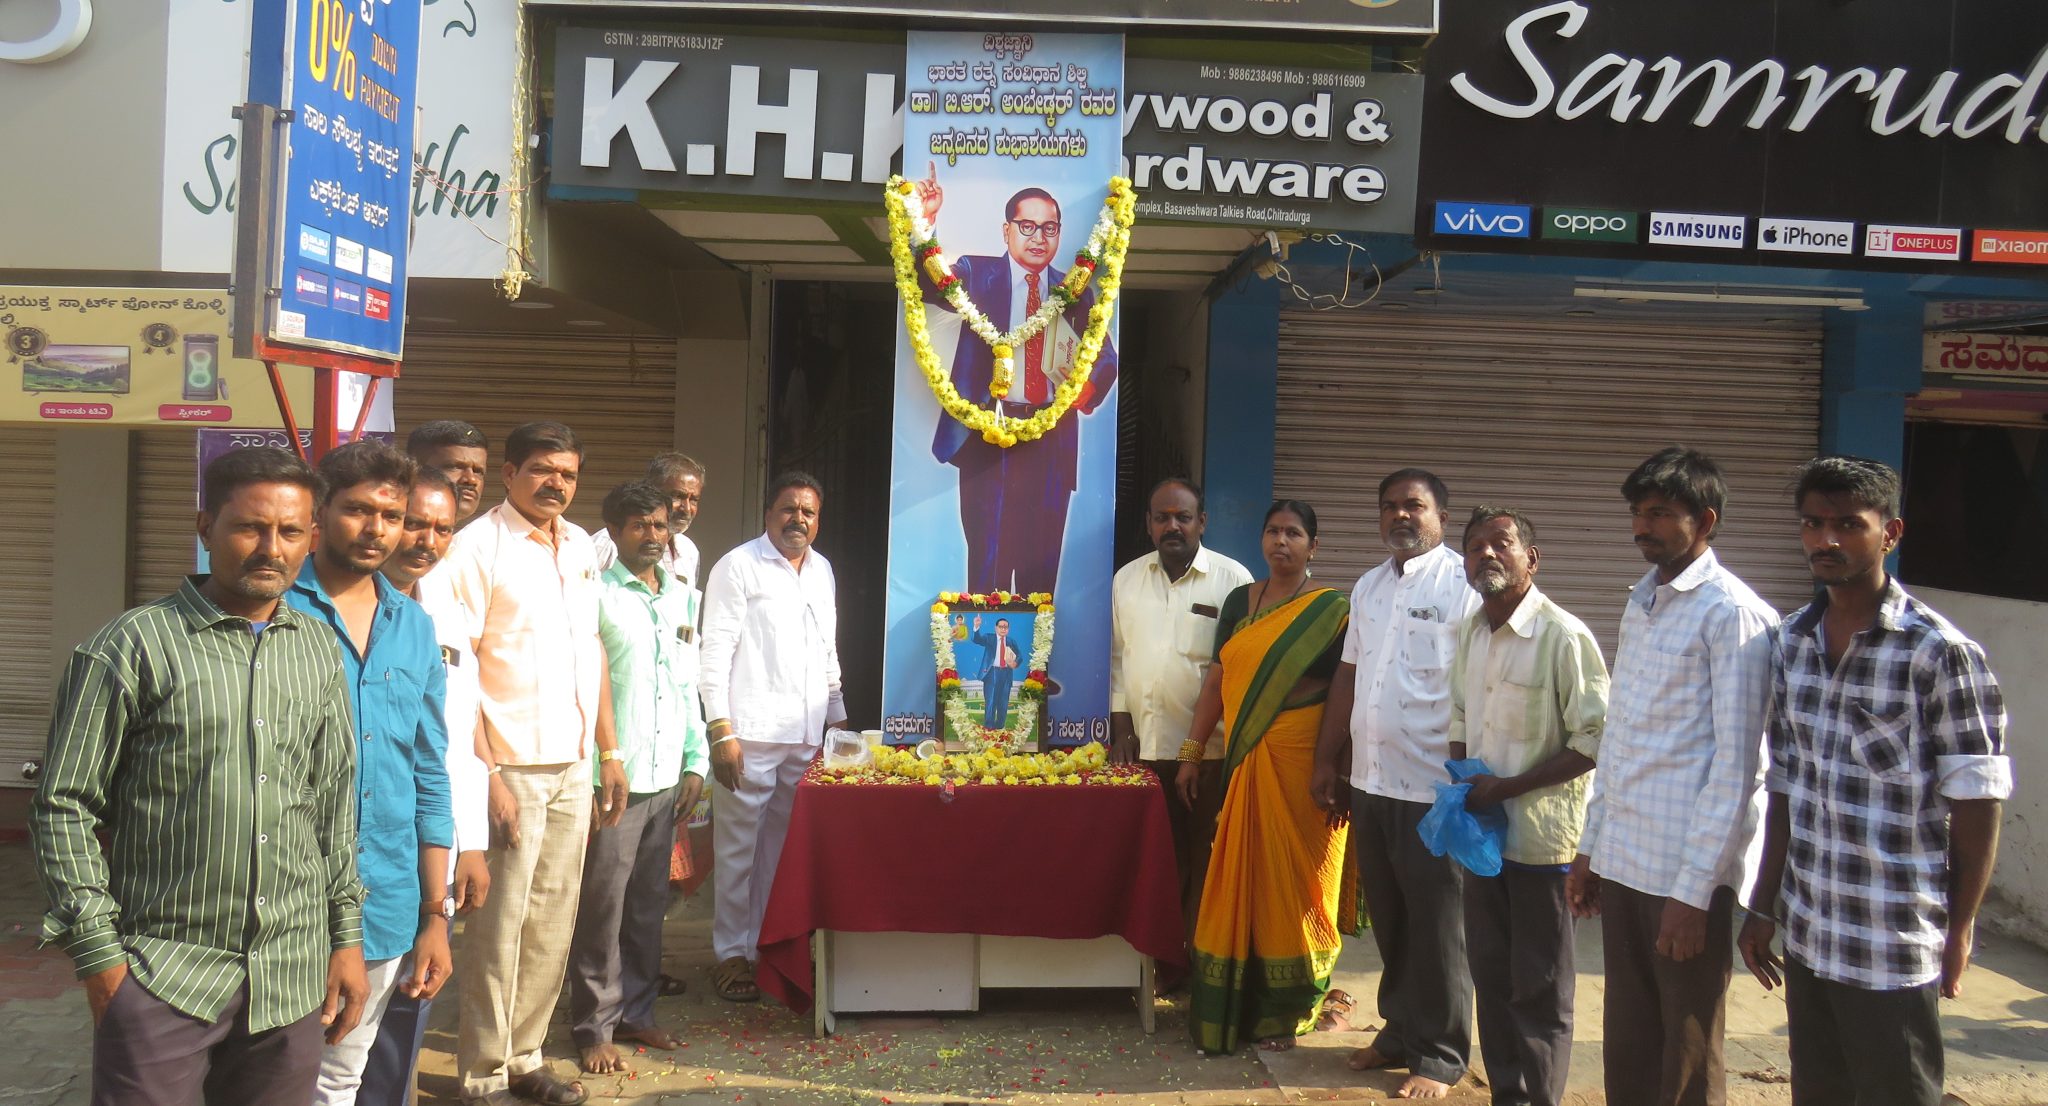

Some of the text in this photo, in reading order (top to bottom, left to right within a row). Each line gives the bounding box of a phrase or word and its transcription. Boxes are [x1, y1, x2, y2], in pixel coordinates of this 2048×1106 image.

[309, 0, 357, 102] 0%
[604, 32, 634, 46] GSTIN
[641, 34, 724, 50] 29BITPK5183J1ZF
[928, 61, 1088, 89] ಭಾರತ ರತ್ನ ಸಂವಿಧಾನ ಶಿಲ್ಪಿ
[1200, 65, 1221, 80] Mob
[1228, 67, 1282, 83] 9886238496
[1284, 72, 1305, 85] Mob
[1312, 75, 1366, 88] 9886116909
[1450, 0, 2048, 145] Samrud
[360, 73, 401, 124] PAYMENT
[1002, 87, 1073, 127] ಅಂಬೇಡ್ಕರ್
[1080, 88, 1116, 116] ರವರ
[1123, 92, 1392, 144] ywood &
[930, 127, 1087, 167] ಜನ್ಮದಿನದ ಶುಭಾಶಯಗಳು
[1122, 146, 1387, 202] rdware
[1134, 201, 1163, 216] omplex,
[1164, 203, 1217, 217] Basaveshwara
[1219, 205, 1244, 219] Talkies
[1443, 208, 1524, 234] vivo
[1553, 214, 1627, 234] oppo
[1652, 220, 1743, 241] SAMSUNG
[1783, 226, 1849, 248] iPhone
[1896, 237, 1954, 250] ONEPLUS
[885, 713, 933, 738] ಚಿತ್ರದುರ್ಗ
[1059, 718, 1085, 740] ಸಂಘ
